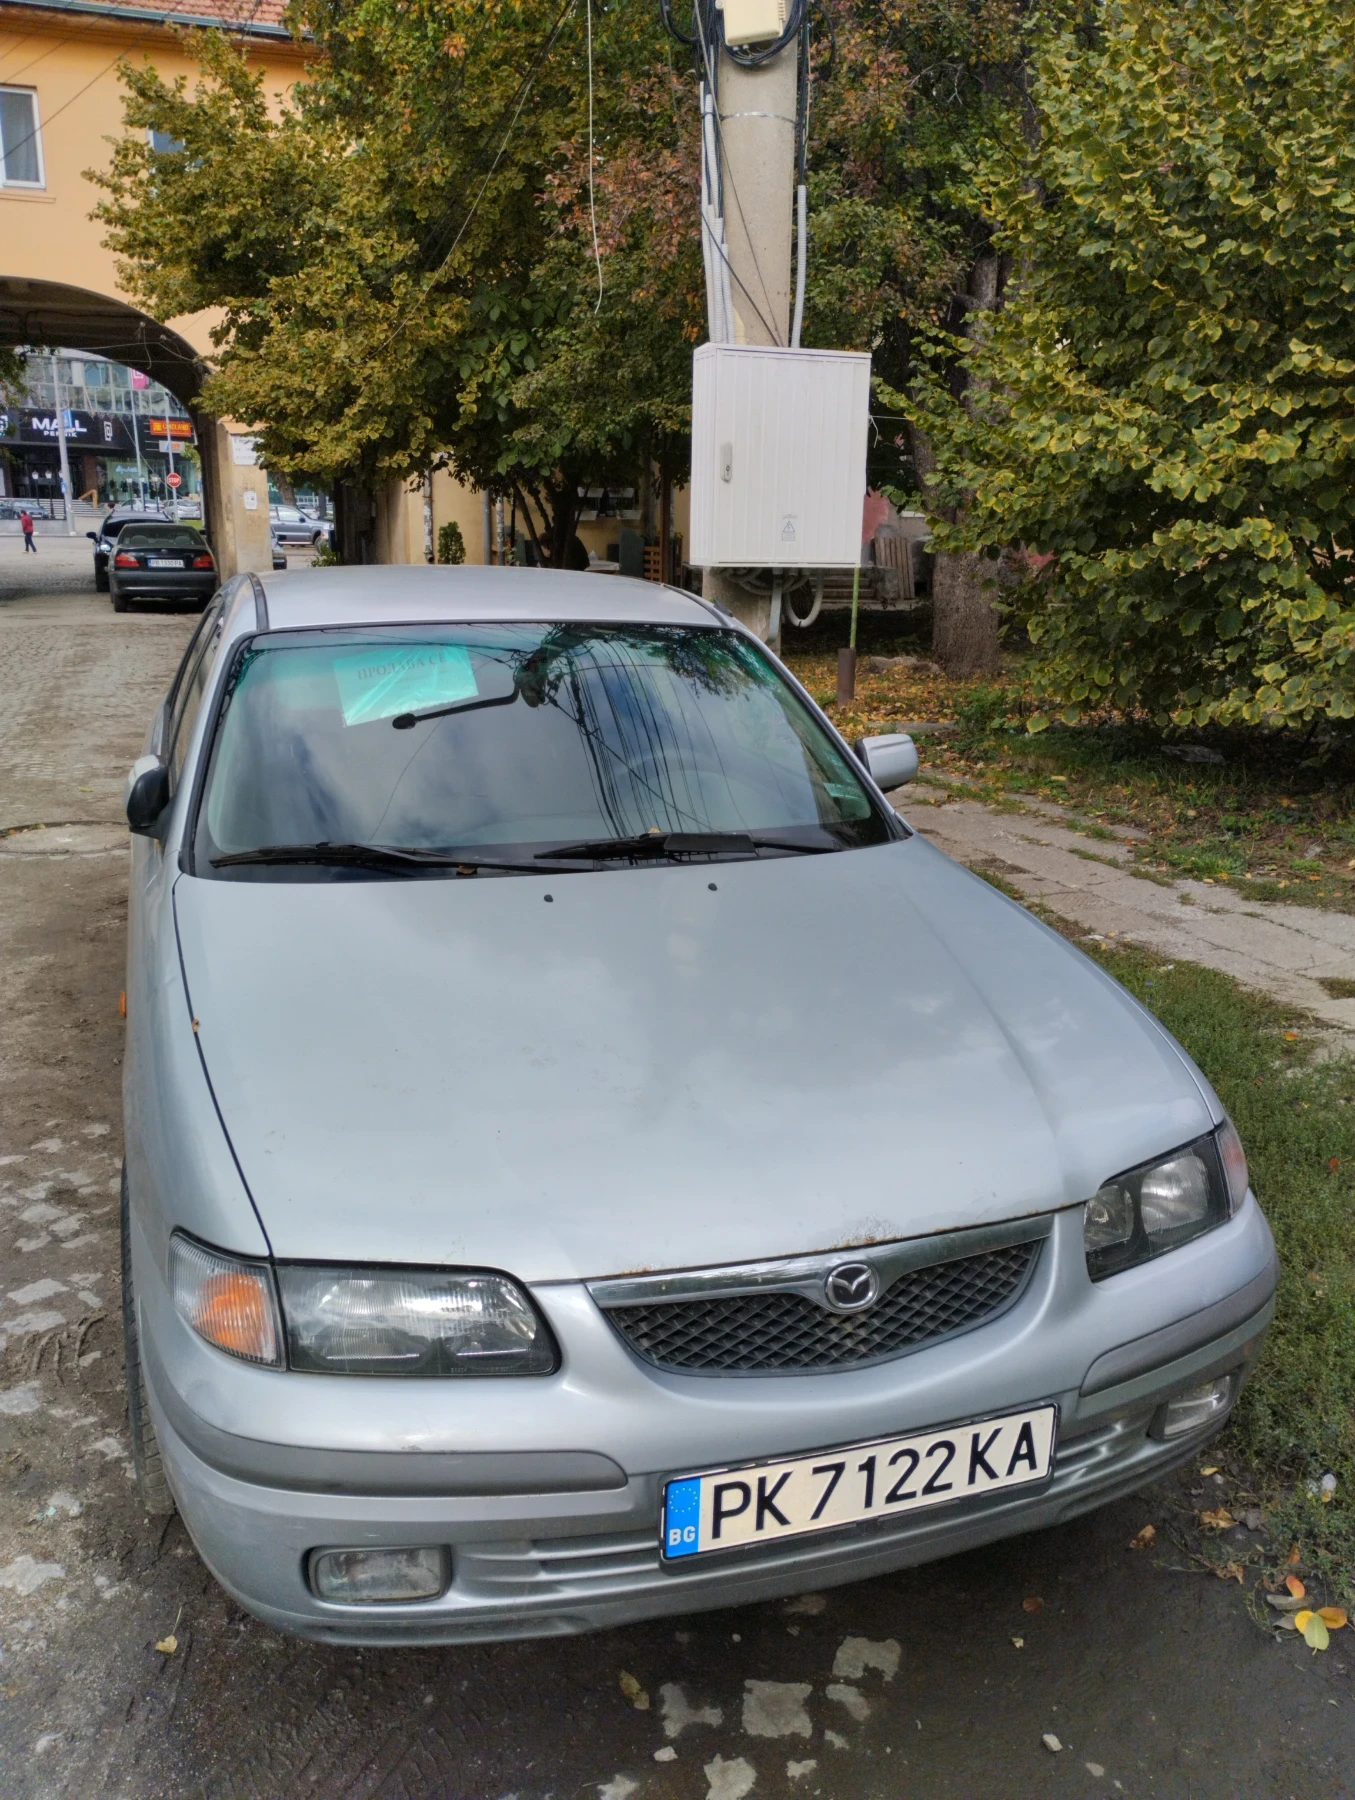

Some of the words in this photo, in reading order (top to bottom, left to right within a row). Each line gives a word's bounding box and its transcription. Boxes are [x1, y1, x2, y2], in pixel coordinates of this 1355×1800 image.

[163, 423, 189, 431] CNELAND
[357, 657, 425, 680] ПРОДАВА
[428, 651, 447, 665] СЕ
[711, 1470, 792, 1540] PK
[809, 1439, 957, 1521] 7122
[967, 1421, 1039, 1487] KA
[668, 1526, 696, 1547] BG
